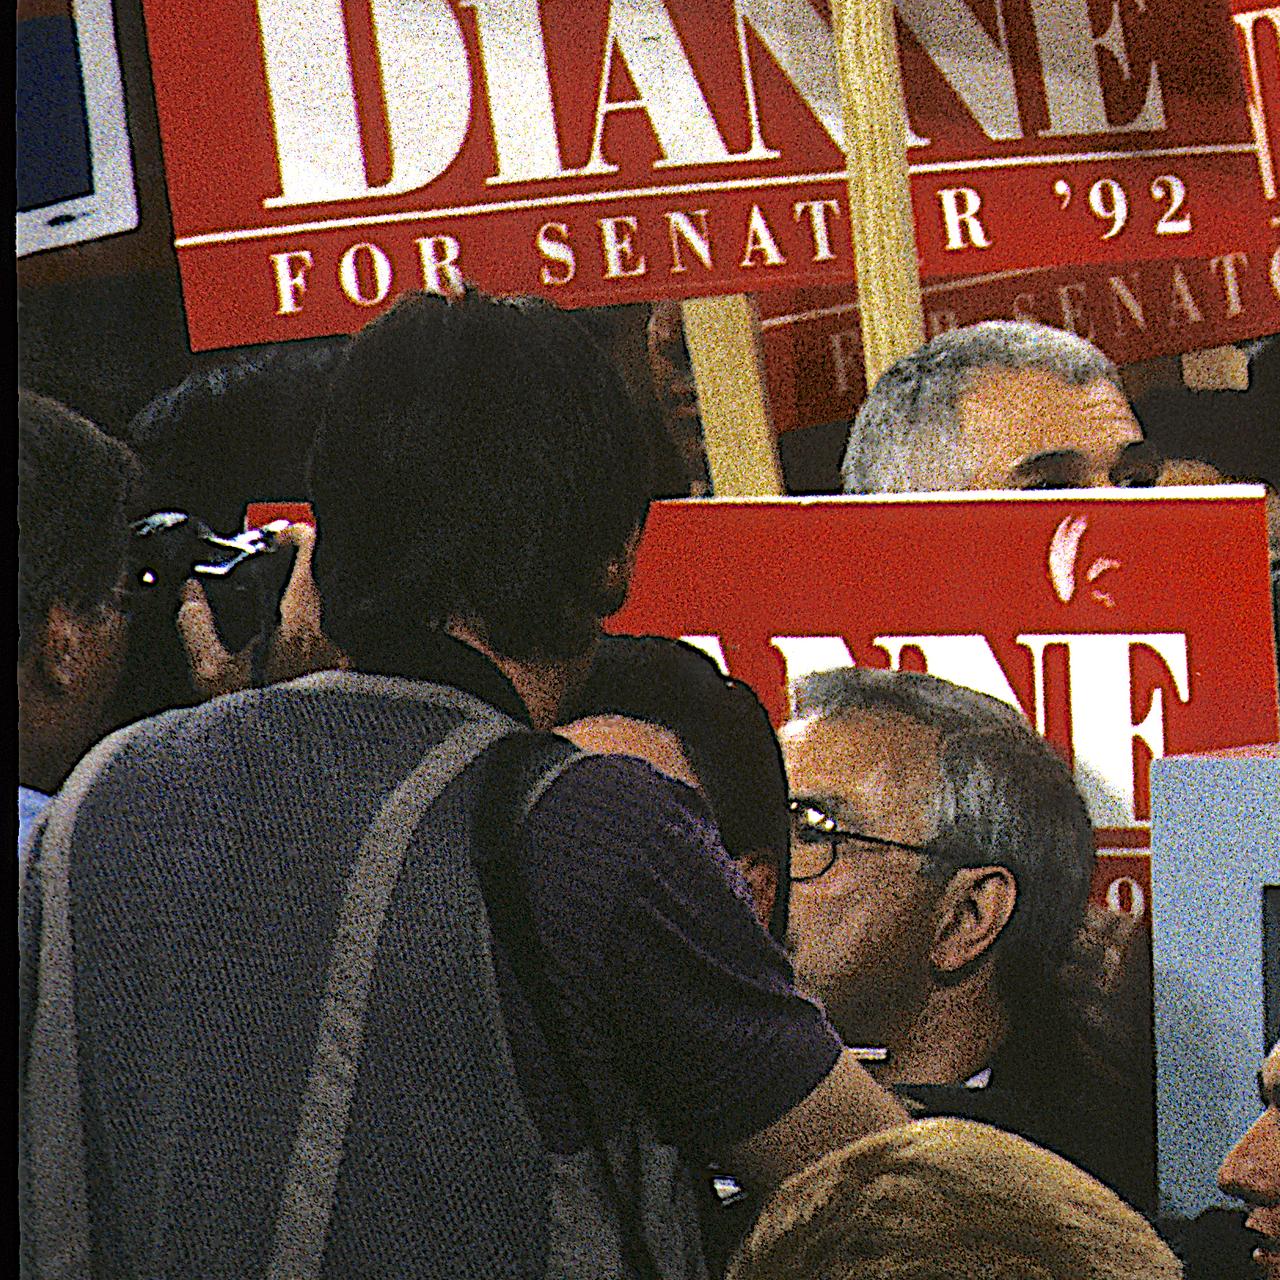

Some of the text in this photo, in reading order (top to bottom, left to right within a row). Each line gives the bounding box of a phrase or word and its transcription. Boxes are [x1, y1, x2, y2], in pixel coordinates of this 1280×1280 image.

[271, 175, 1192, 316] FOR SENATR '92
